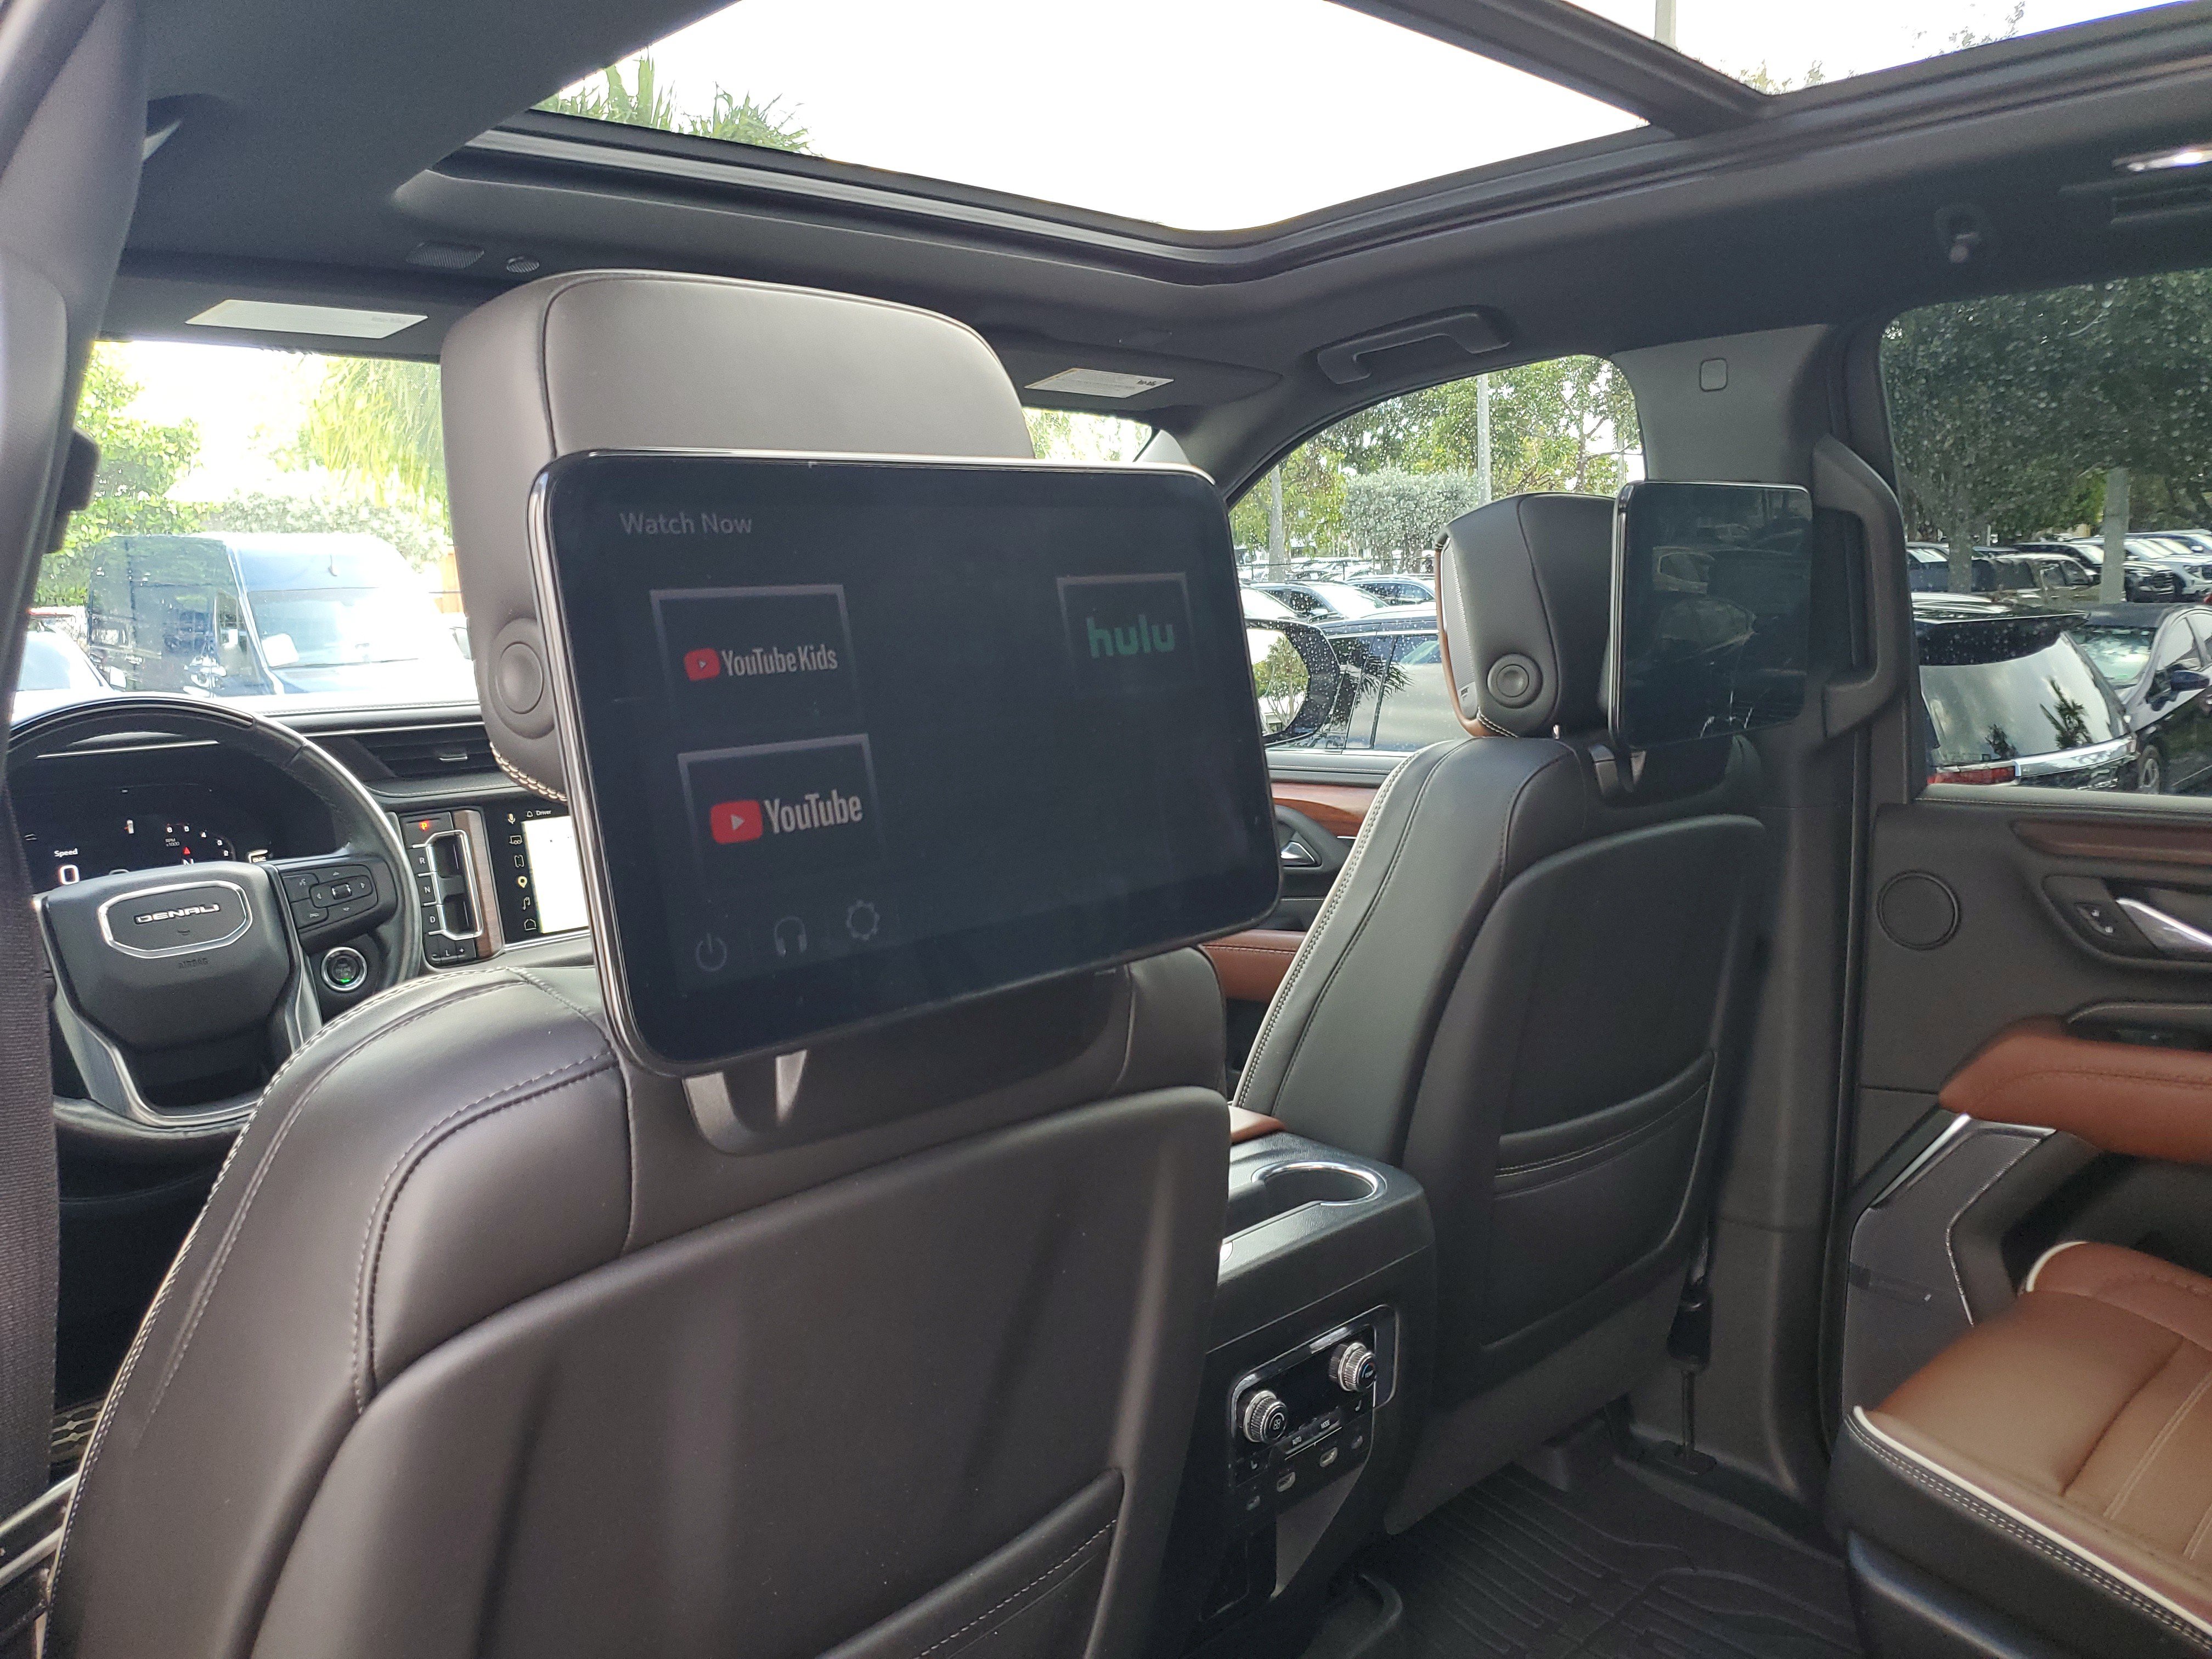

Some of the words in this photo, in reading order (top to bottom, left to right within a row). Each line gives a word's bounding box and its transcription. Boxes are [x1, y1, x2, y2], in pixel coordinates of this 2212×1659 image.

[620, 511, 695, 534] Watch
[701, 512, 752, 534] Now
[1086, 614, 1176, 658] hulu
[764, 788, 863, 834] YouTube
[421, 822, 427, 831] P
[54, 848, 78, 857] Speed
[59, 864, 80, 885] 0
[137, 904, 220, 923] DENALI
